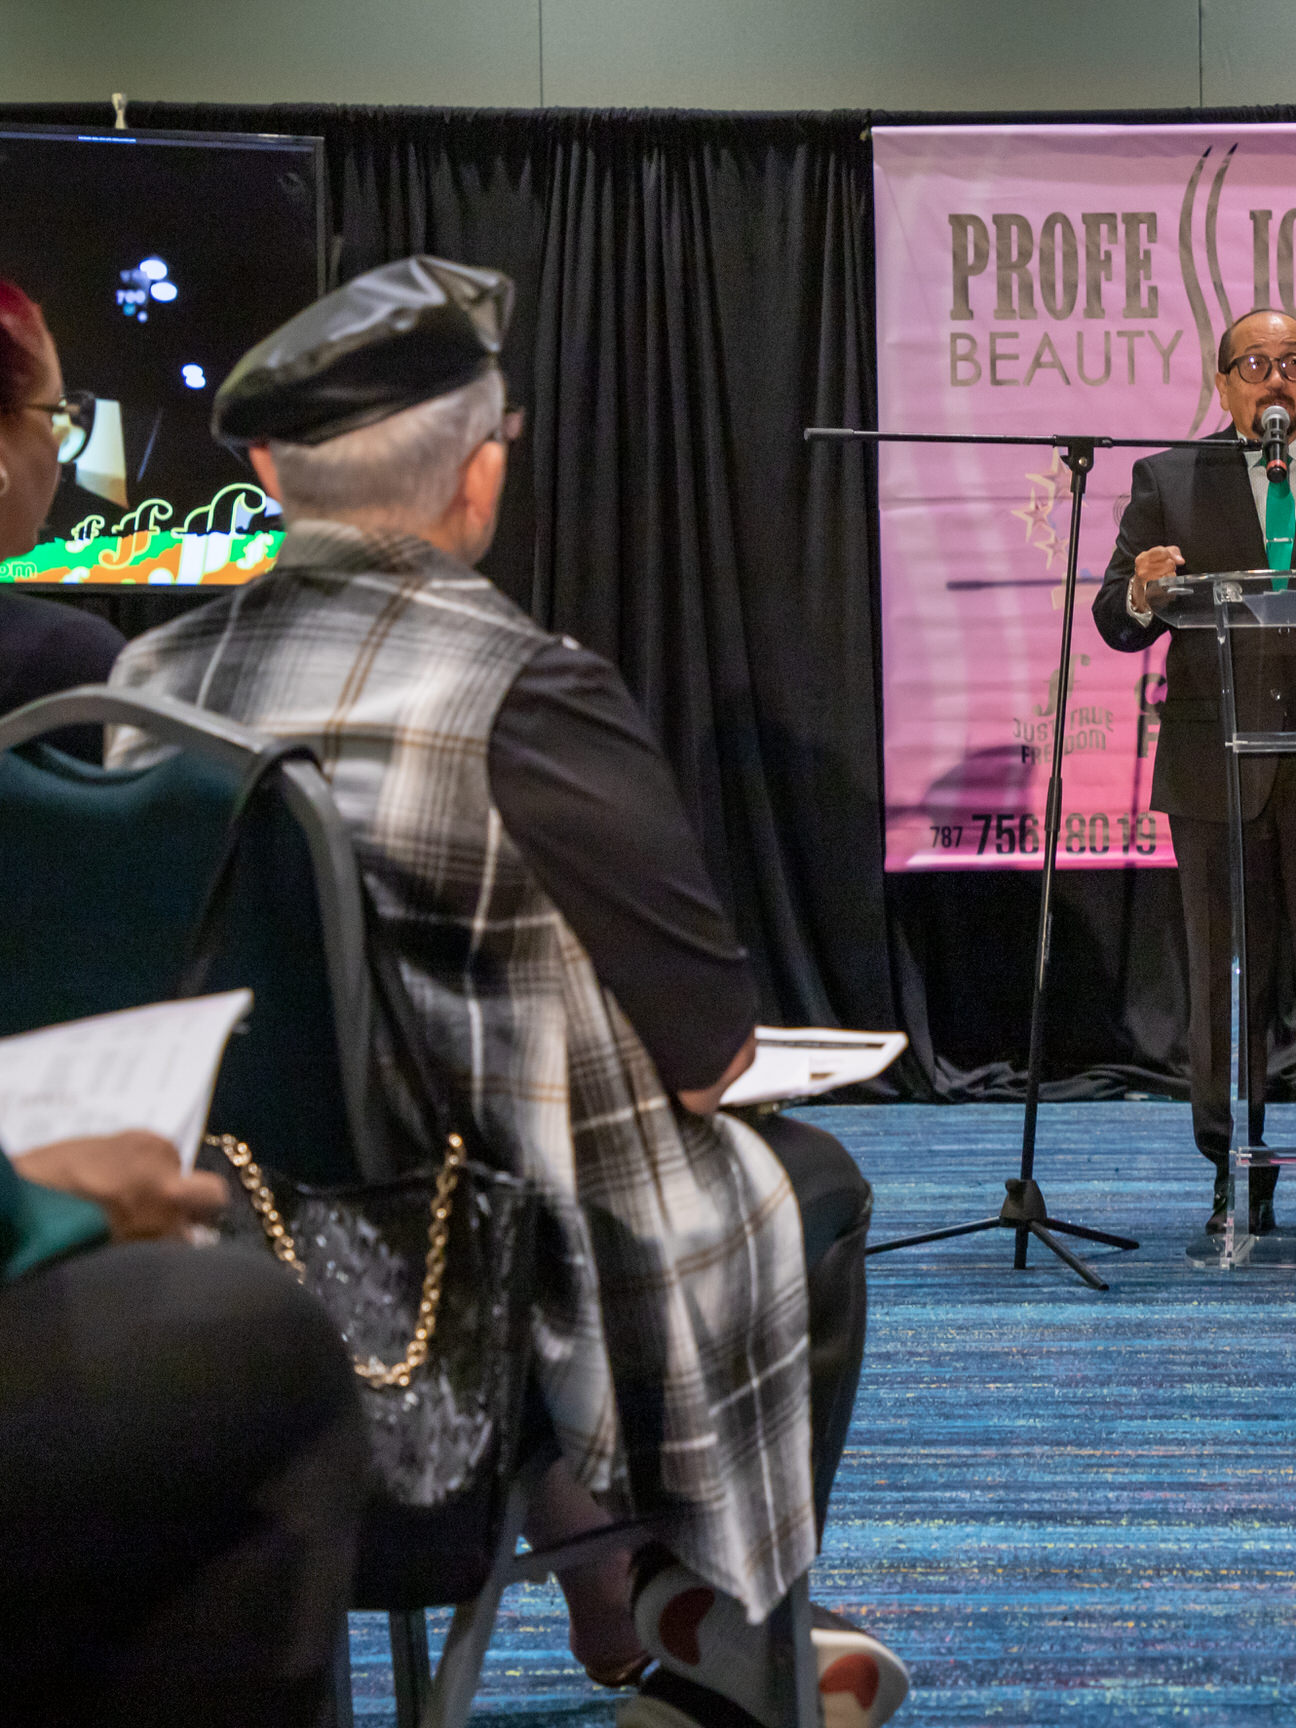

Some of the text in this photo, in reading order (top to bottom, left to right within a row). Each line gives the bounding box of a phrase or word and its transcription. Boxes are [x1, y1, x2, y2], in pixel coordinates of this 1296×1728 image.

[949, 329, 1183, 387] BEAUTY
[1021, 729, 1107, 766] FREDOM
[930, 826, 963, 849] 787
